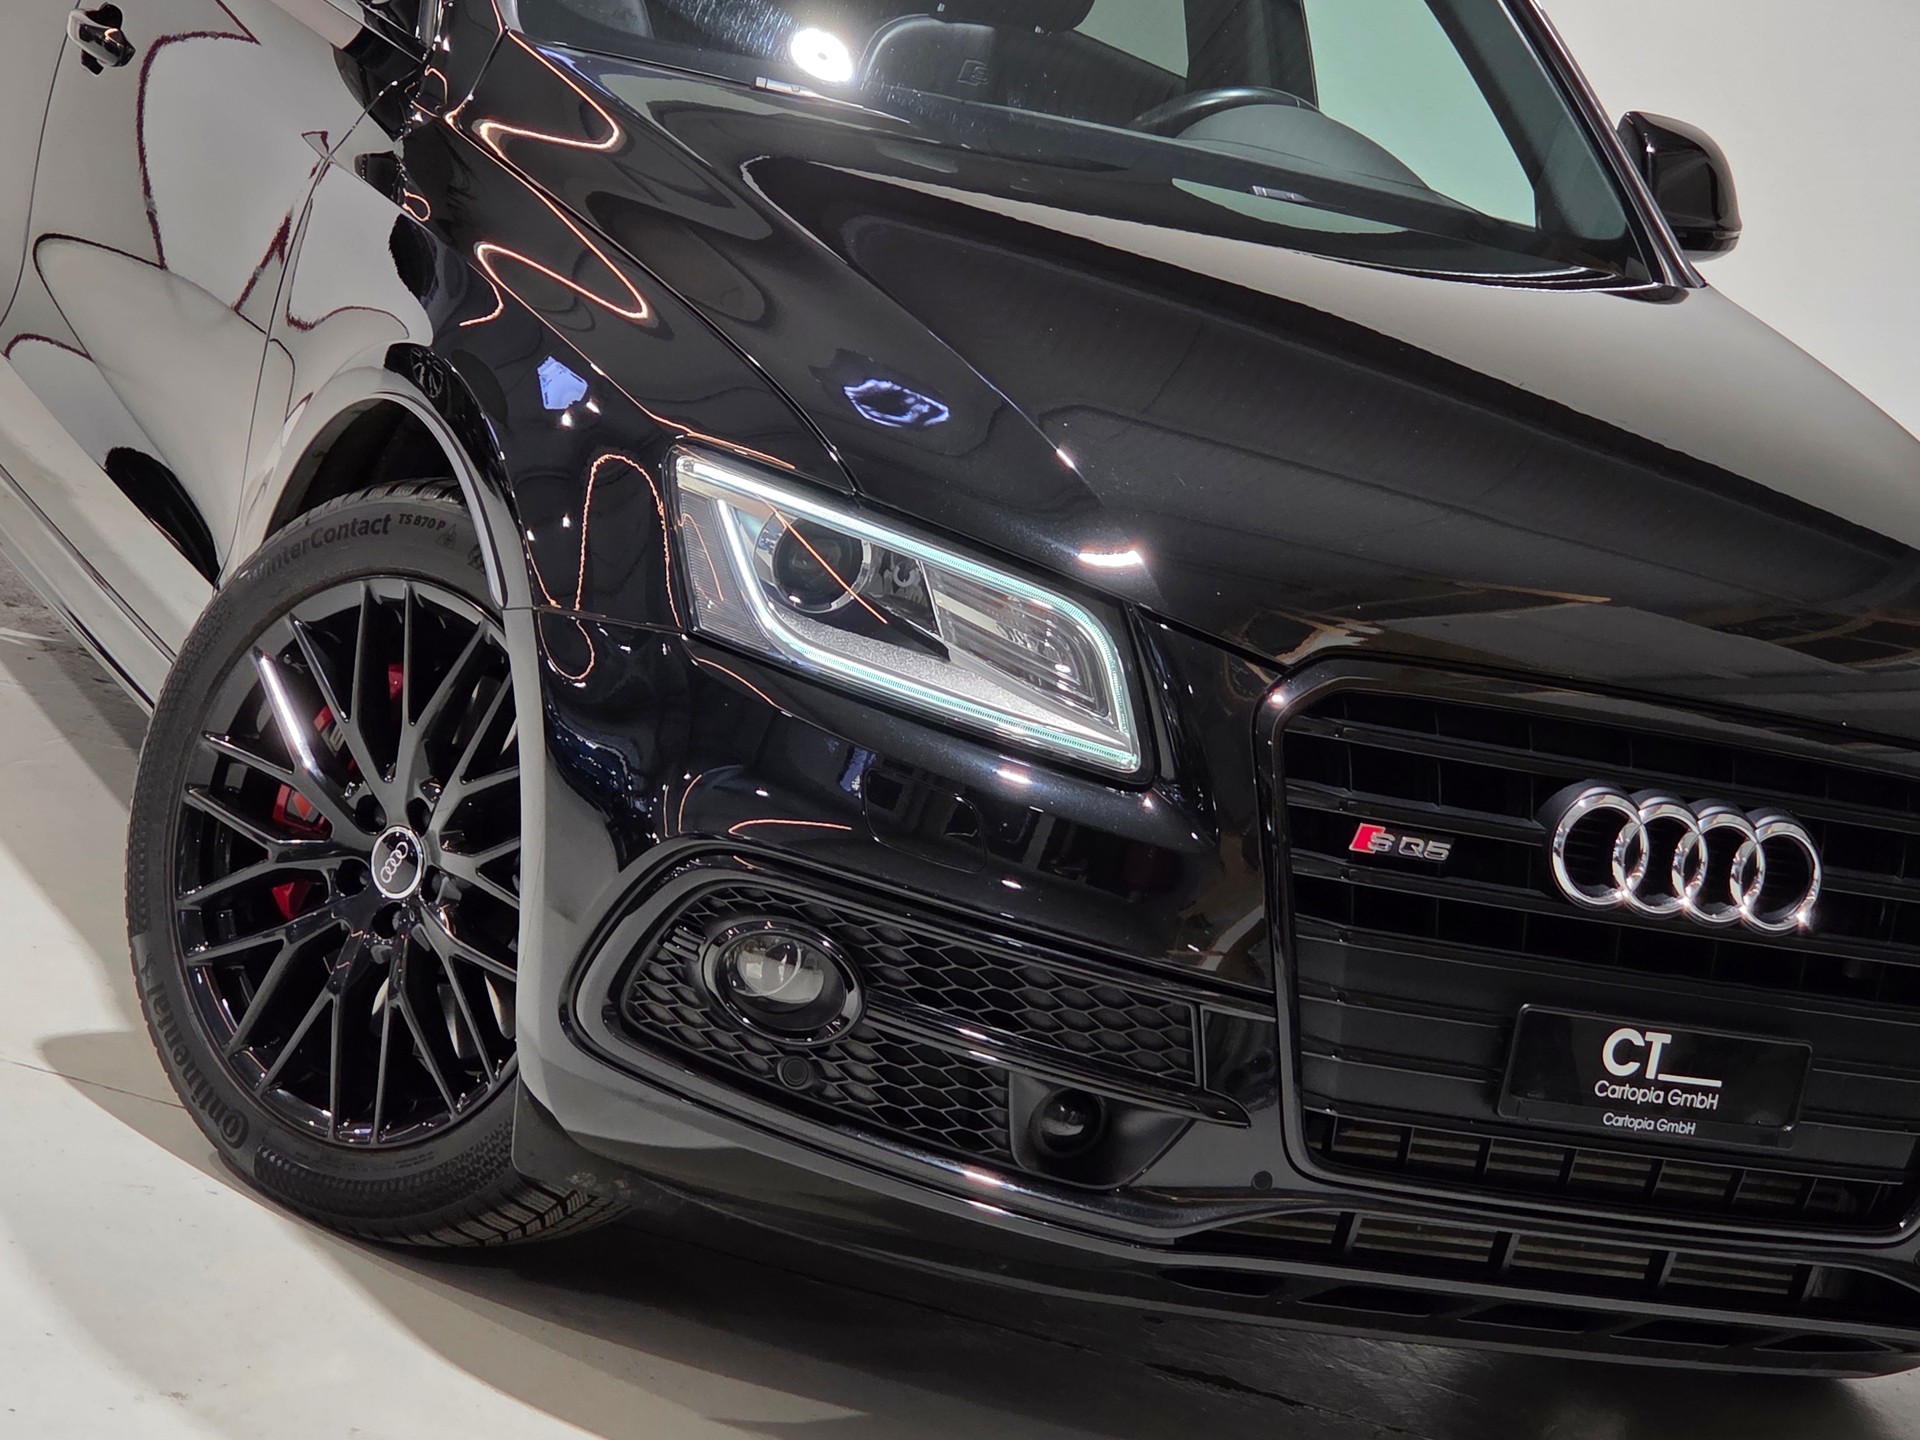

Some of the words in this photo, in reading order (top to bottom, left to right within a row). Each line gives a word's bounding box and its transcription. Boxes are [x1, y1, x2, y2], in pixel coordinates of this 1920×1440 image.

[436, 520, 446, 531] P
[146, 980, 248, 1149] Continental
[1594, 1080, 1665, 1105] Cartopia
[1667, 1088, 1719, 1111] GmbH
[1602, 1112, 1655, 1132] Cartopia
[1656, 1118, 1697, 1136] GmbH
